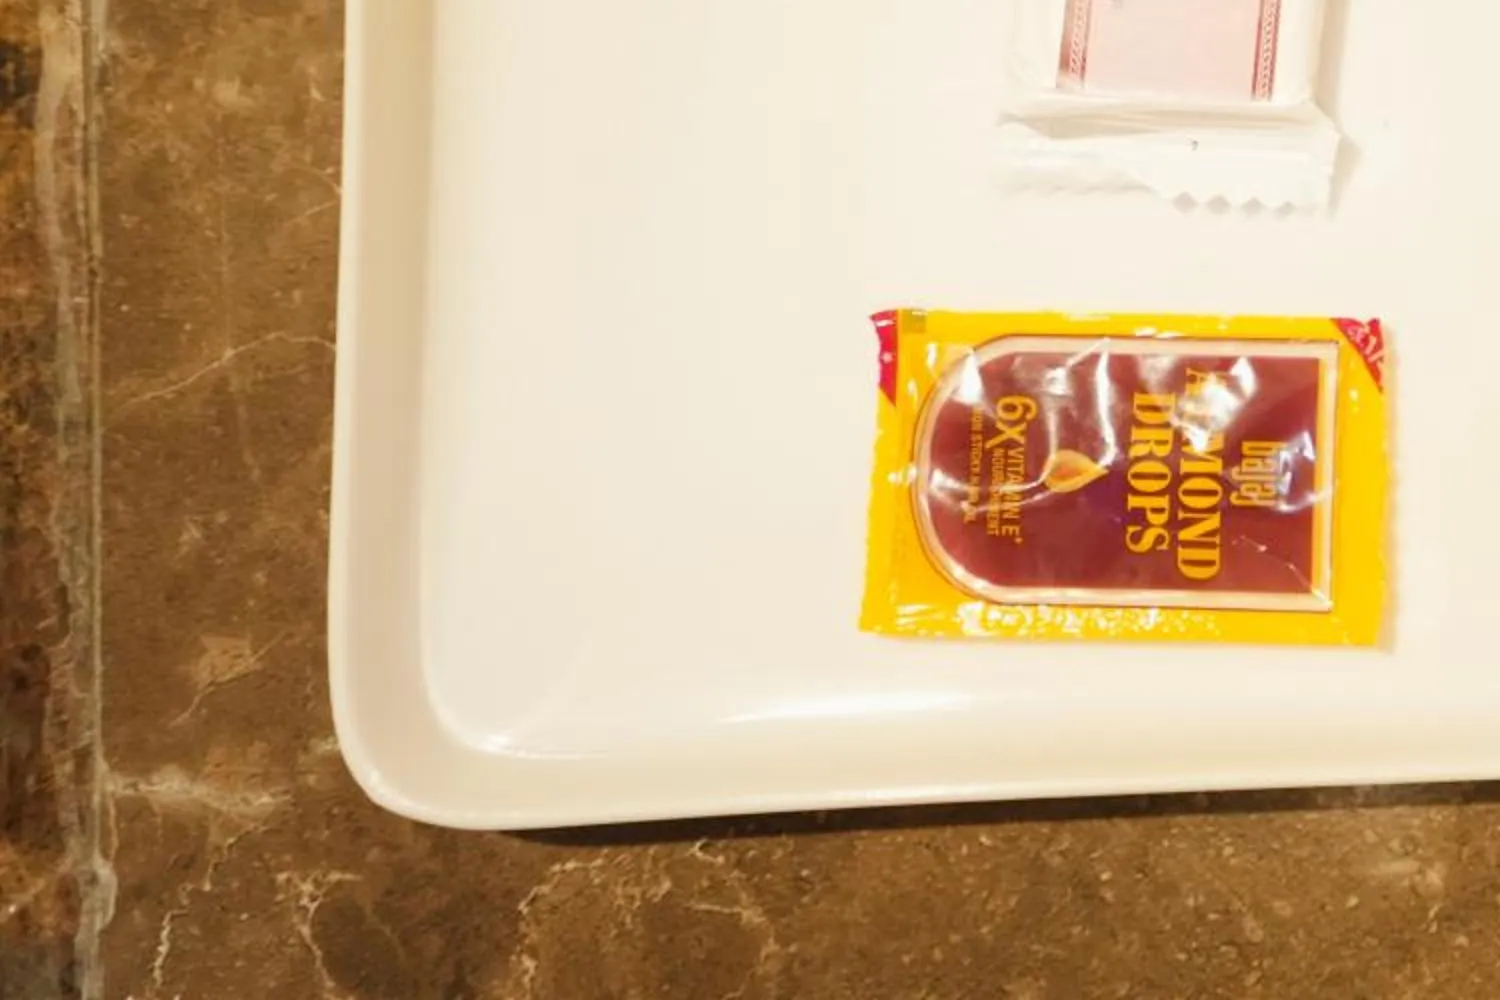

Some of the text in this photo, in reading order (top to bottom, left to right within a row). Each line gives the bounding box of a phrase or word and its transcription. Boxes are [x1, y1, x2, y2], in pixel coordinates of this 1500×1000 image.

[1125, 392, 1176, 554] DROPS
[1176, 367, 1228, 581] AMOND
[1230, 441, 1288, 507] bajaj
